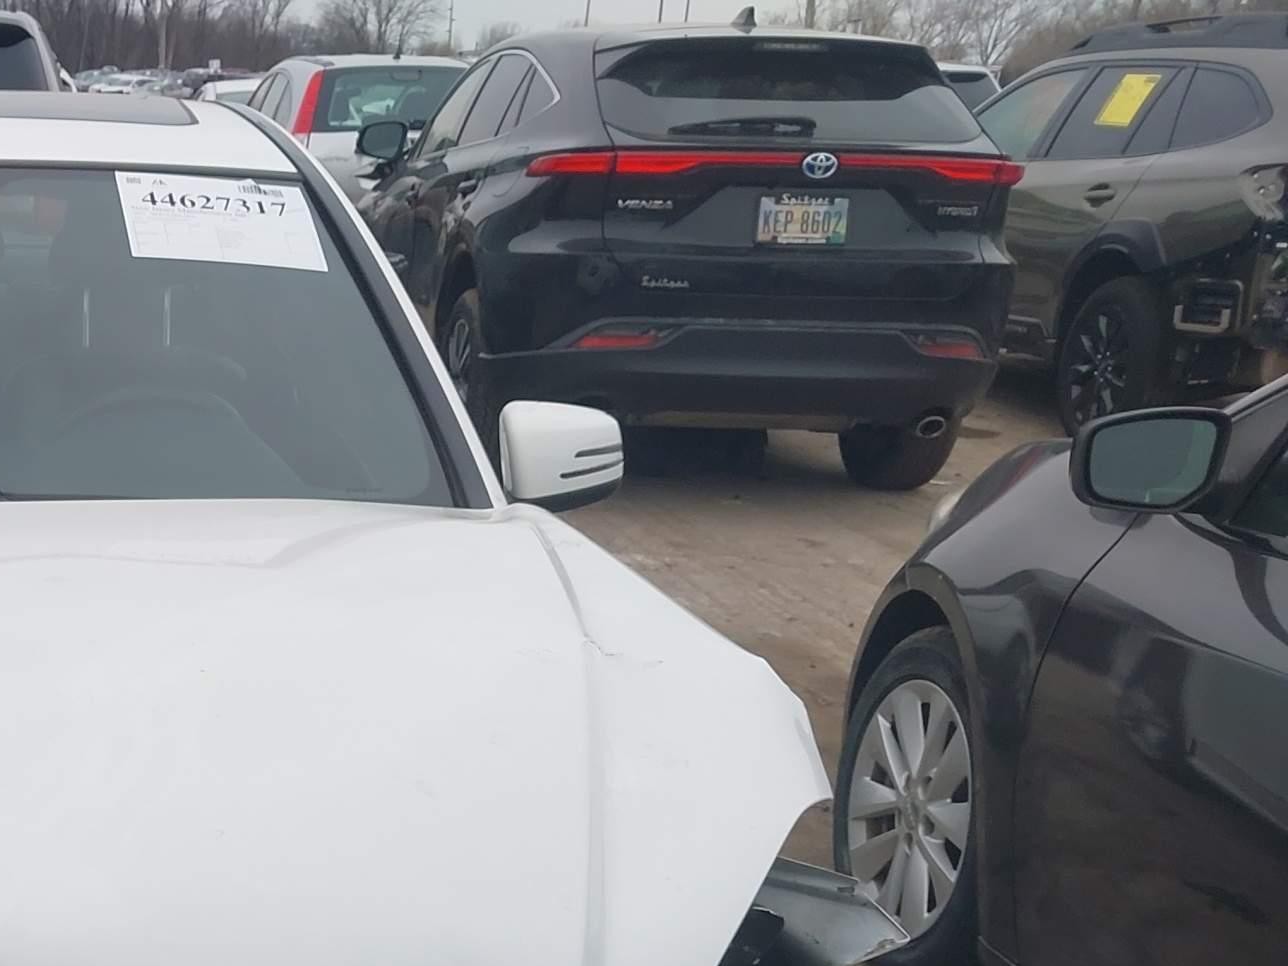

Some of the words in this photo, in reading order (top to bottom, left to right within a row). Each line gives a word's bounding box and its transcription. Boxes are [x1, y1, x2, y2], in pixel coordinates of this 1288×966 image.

[141, 191, 286, 217] 44627317
[617, 199, 673, 209] VENZA
[762, 209, 794, 234] KEP
[800, 209, 842, 234] 8602
